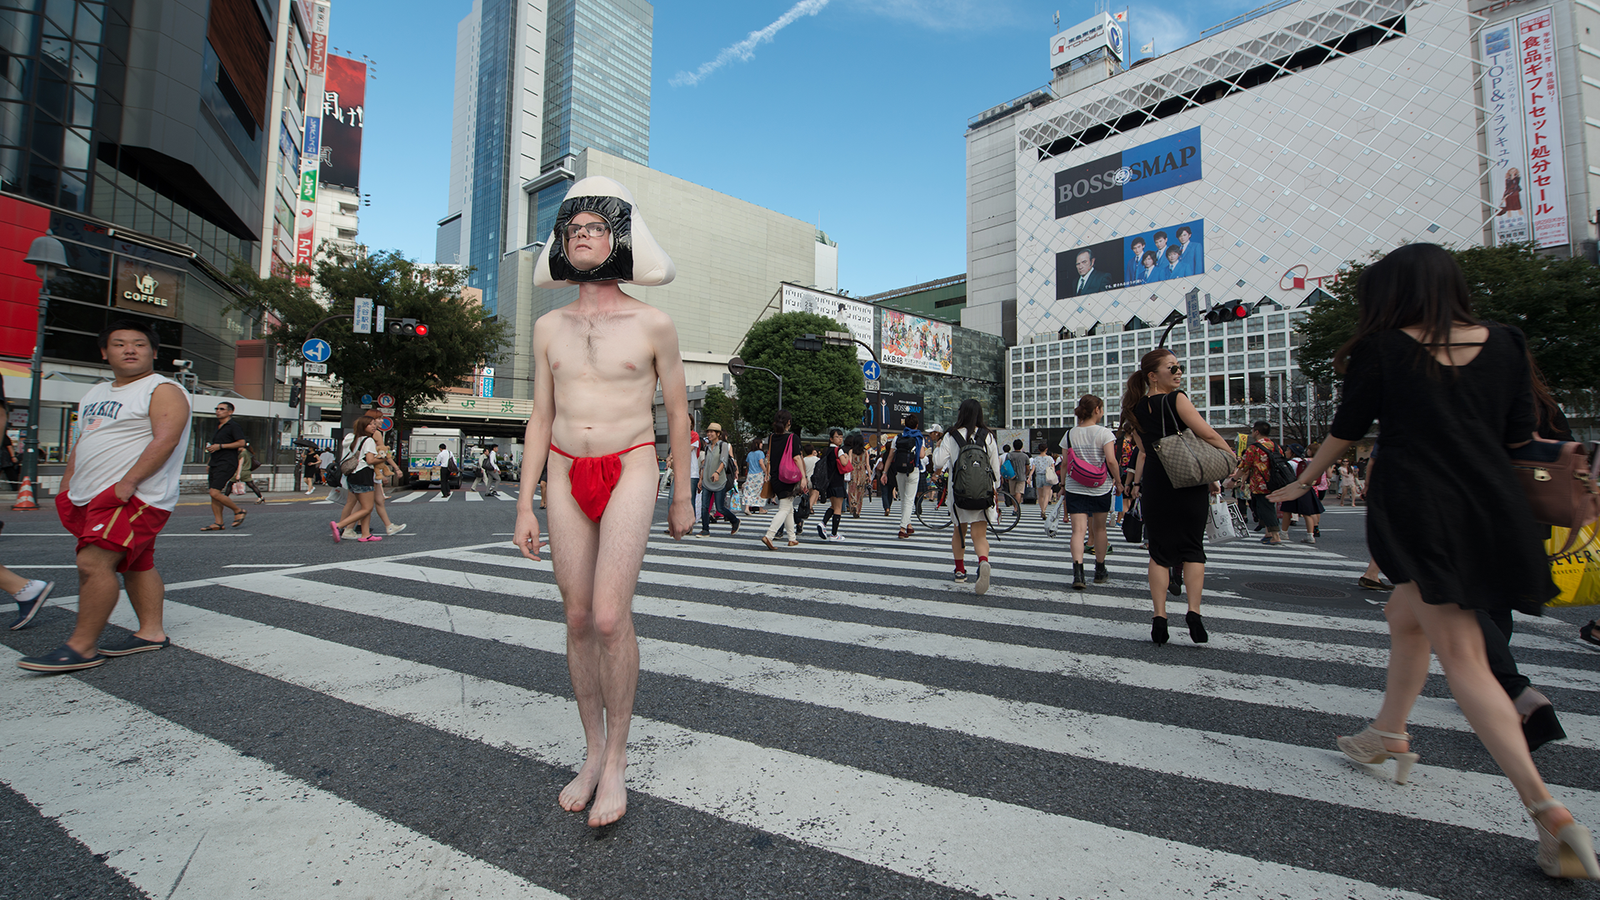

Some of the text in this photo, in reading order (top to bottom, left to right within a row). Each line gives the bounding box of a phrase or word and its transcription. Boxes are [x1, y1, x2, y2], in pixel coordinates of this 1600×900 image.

[1065, 30, 1104, 50] TOKYU
[312, 41, 325, 71] アイフル
[1522, 35, 1554, 217] 食品ギフトセット処分セール
[1058, 168, 1117, 204] BOSS
[1129, 145, 1197, 183] SMAP
[303, 175, 314, 196] レイク
[123, 290, 168, 307] COFFEE
[361, 300, 370, 331] 渋谷駅前
[882, 354, 904, 365] AKB48
[82, 400, 124, 420] WAIKIKI
[461, 400, 515, 413] JR 渋
[893, 404, 922, 414] BOSS SMAP
[1548, 549, 1596, 566] EVER
